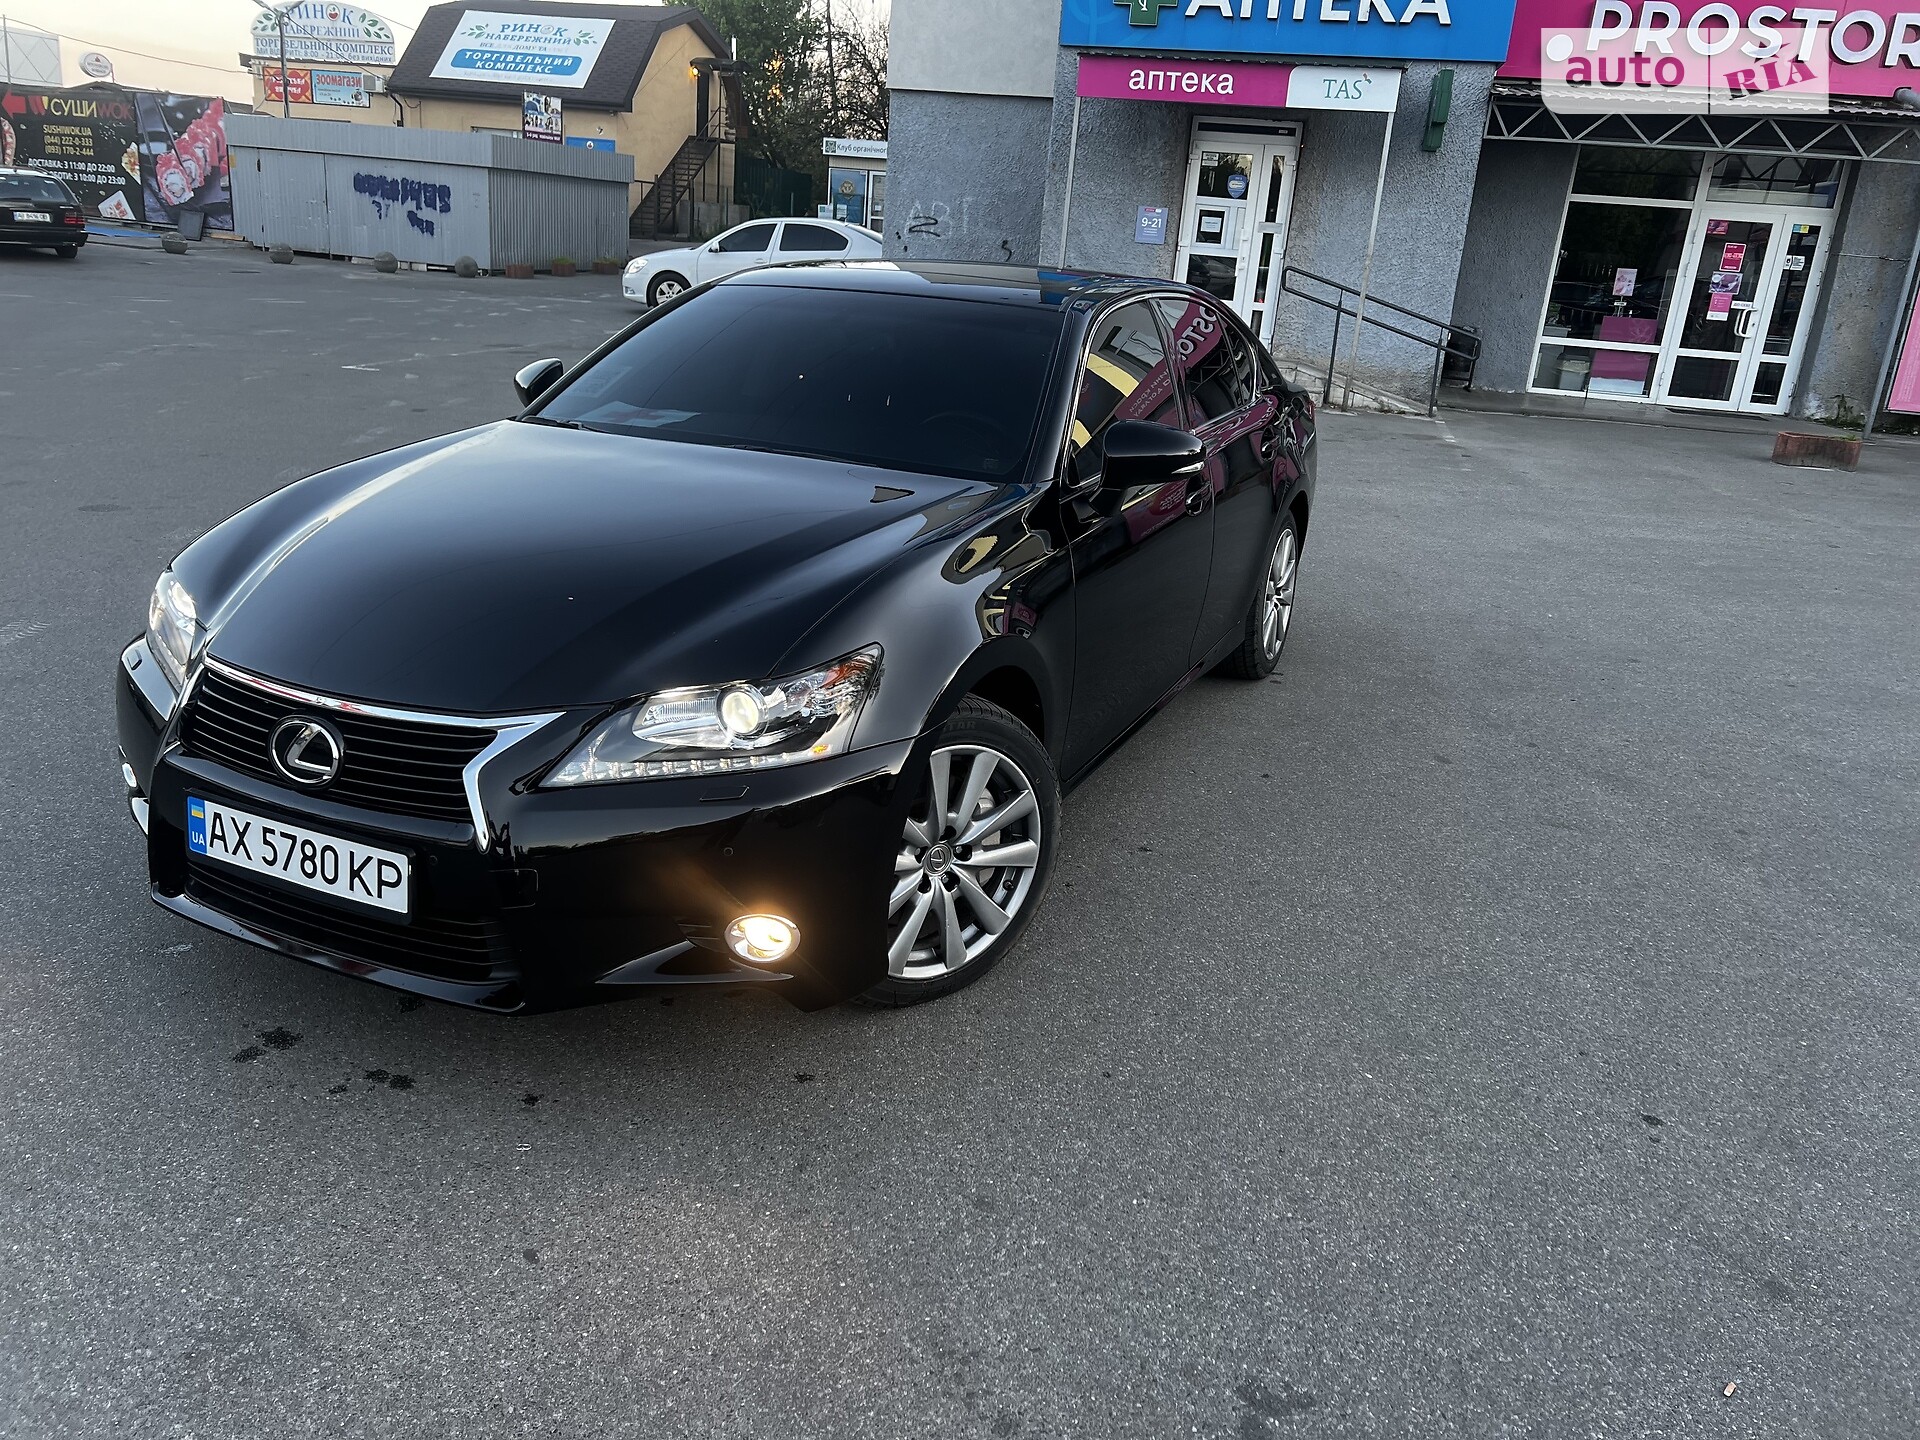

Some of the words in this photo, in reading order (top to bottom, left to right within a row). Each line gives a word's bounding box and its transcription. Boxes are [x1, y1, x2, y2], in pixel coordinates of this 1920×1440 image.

[284, 23, 360, 38] АБЕРЕЖНИЙ
[485, 32, 572, 46] НАБЕРЕЖНИЙ
[255, 38, 333, 51] ТОРГВЕЛЬНИЙ
[335, 42, 394, 56] КОМПЛЕКС
[465, 51, 574, 67] ТОРГІВЕЛЬНИЙ
[475, 60, 553, 74] КОМПЛЕКС
[316, 72, 362, 87] зоомагази
[1128, 68, 1235, 96] аптека
[1322, 78, 1363, 100] TAS
[50, 98, 98, 118] СУШИ
[43, 124, 92, 136] SUSHIWOK.UA
[44, 136, 61, 145] (044)
[61, 136, 93, 147] 222-0-333
[837, 144, 852, 153] Клуб
[853, 145, 887, 154] органічног
[45, 146, 62, 155] (093)
[63, 146, 94, 156] 170-2-444
[28, 157, 63, 169] ДОСТАВКА:
[70, 161, 86, 171] 11:00
[87, 162, 97, 172] ДО
[98, 163, 116, 173] 22:00
[79, 173, 97, 182] 10:00
[97, 174, 107, 184] ДО
[108, 175, 126, 185] 23:00
[1141, 217, 1162, 228] 9-21
[192, 831, 205, 846] UA
[209, 811, 253, 861] AX
[262, 825, 339, 885] 5780
[349, 850, 403, 899] KP
